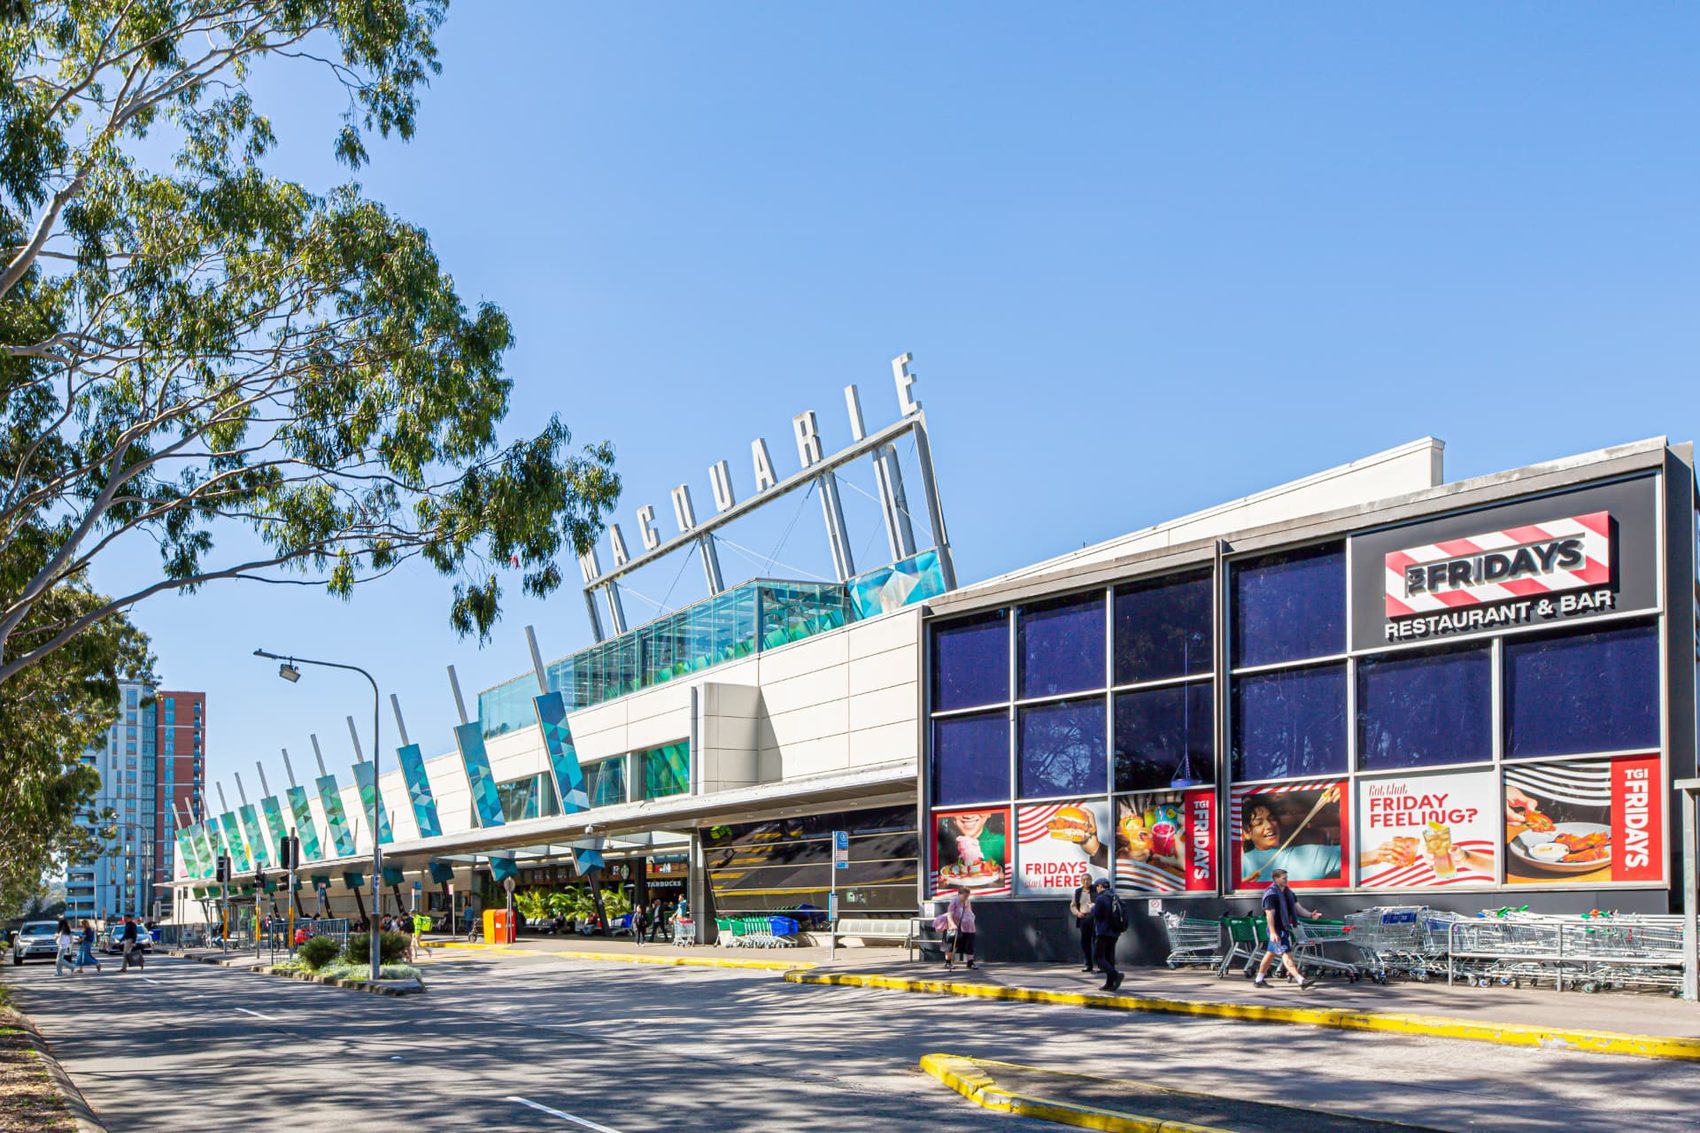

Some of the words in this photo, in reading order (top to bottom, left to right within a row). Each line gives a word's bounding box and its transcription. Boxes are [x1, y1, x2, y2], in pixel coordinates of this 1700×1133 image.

[1427, 539, 1583, 592] FRIDAYS
[1384, 602, 1531, 638] RESTAURANT
[1537, 599, 1554, 616] &
[1560, 590, 1612, 612] BAR
[1624, 768, 1649, 779] TGI
[1370, 793, 1448, 812] FRIDAY
[1370, 808, 1478, 828] FEELING?
[1025, 861, 1088, 875] FRIDAYS
[647, 880, 682, 889] TARBUCKS
[1043, 875, 1081, 888] HERE
